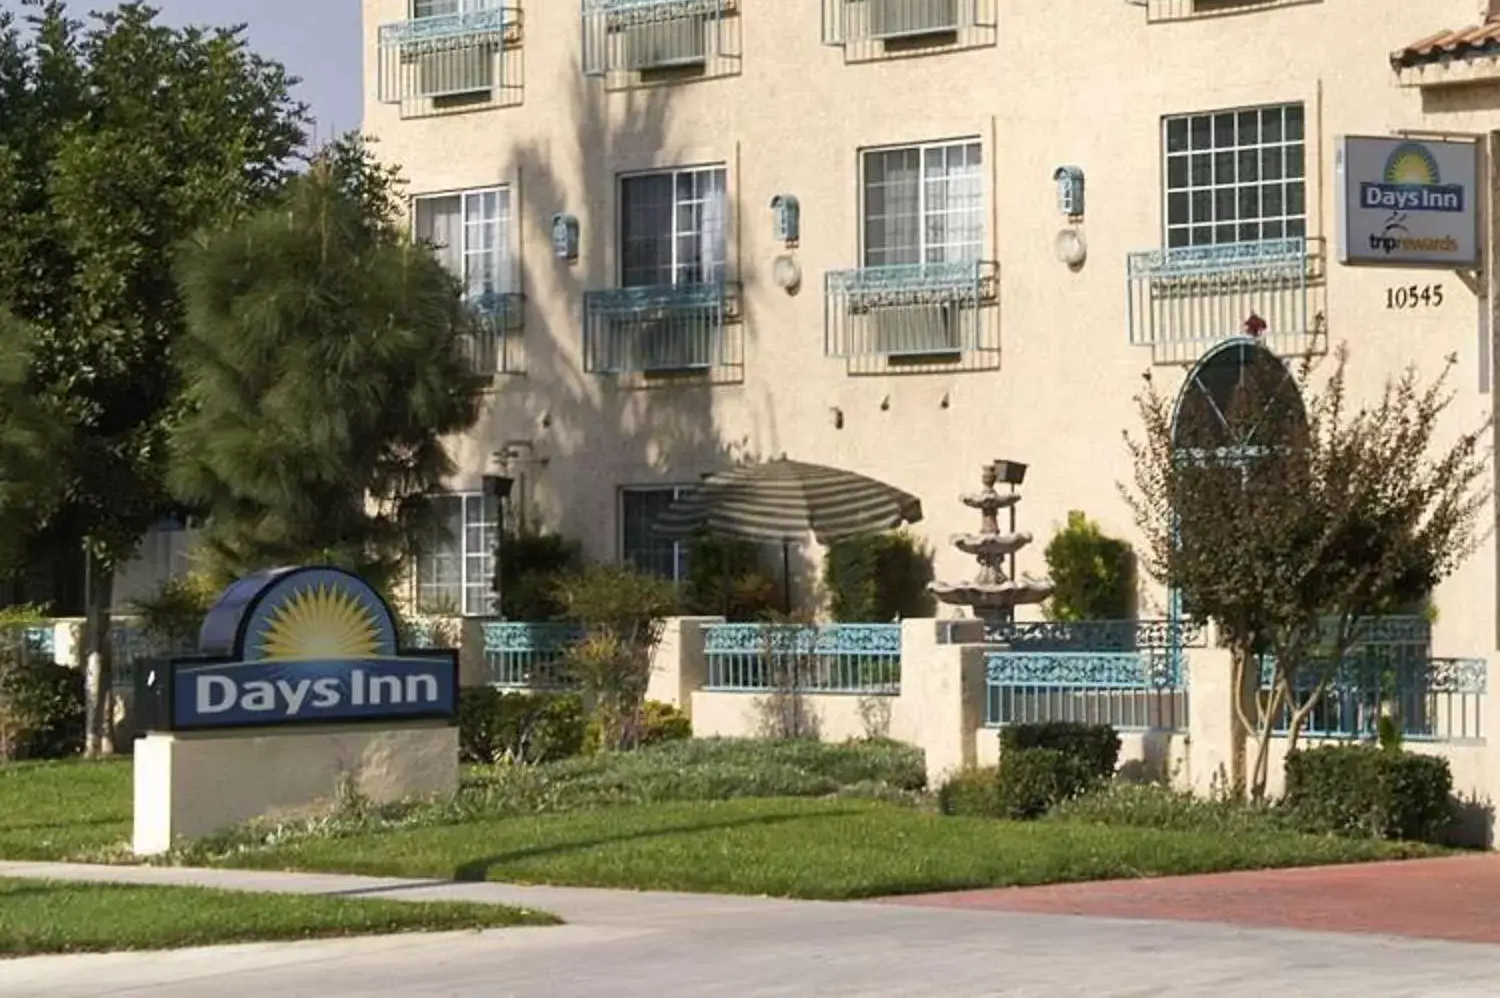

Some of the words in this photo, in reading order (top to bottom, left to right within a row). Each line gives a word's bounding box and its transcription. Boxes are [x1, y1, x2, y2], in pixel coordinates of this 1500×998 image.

[1366, 187, 1419, 208] Days
[1423, 189, 1458, 208] Inn
[1386, 284, 1443, 309] 10545
[196, 675, 341, 715] Days
[351, 669, 438, 705] Inn
